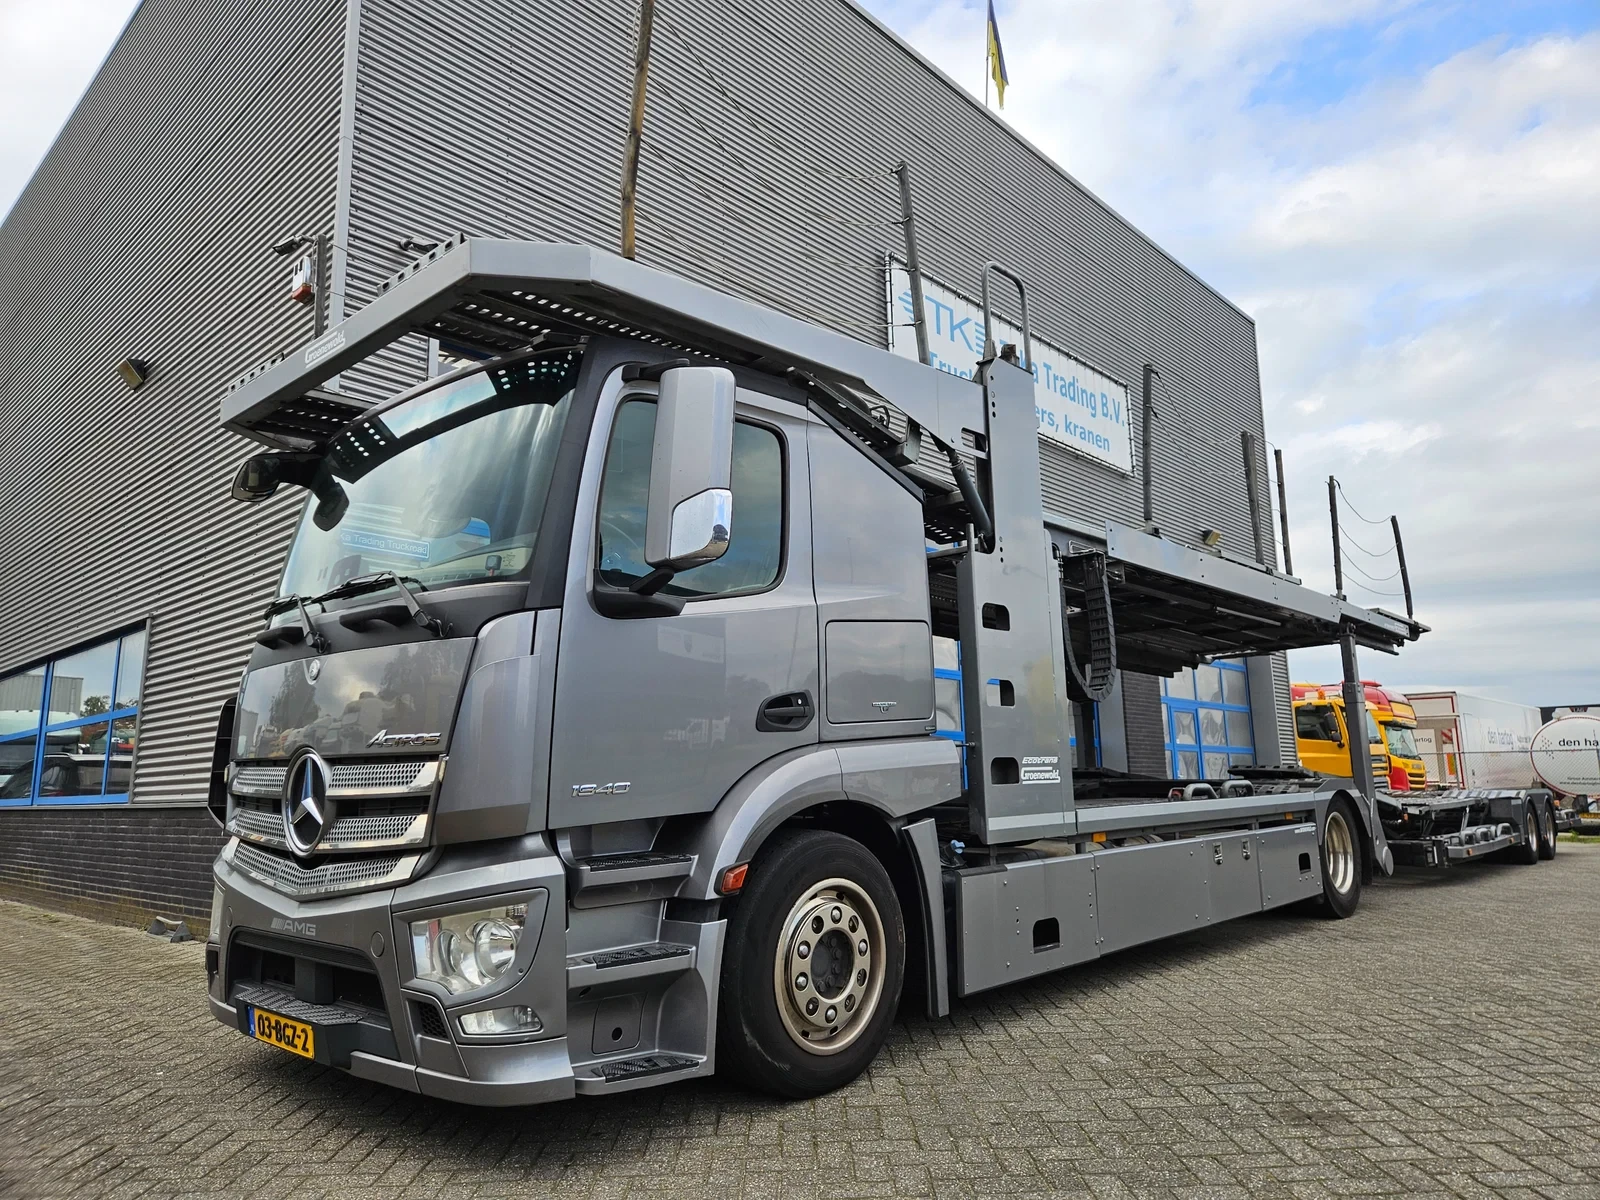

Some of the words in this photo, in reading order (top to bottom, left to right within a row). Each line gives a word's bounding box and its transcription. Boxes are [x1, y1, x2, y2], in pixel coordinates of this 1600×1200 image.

[925, 295, 974, 352] TK
[1043, 362, 1097, 418] Trading
[1101, 392, 1125, 427] B.V.
[1065, 414, 1110, 452] kranen
[354, 534, 385, 548] Trading
[1558, 738, 1580, 747] den
[1021, 766, 1061, 784] Groenewold
[282, 919, 317, 936] AMG
[257, 1013, 310, 1053] 03-BGZ-2
